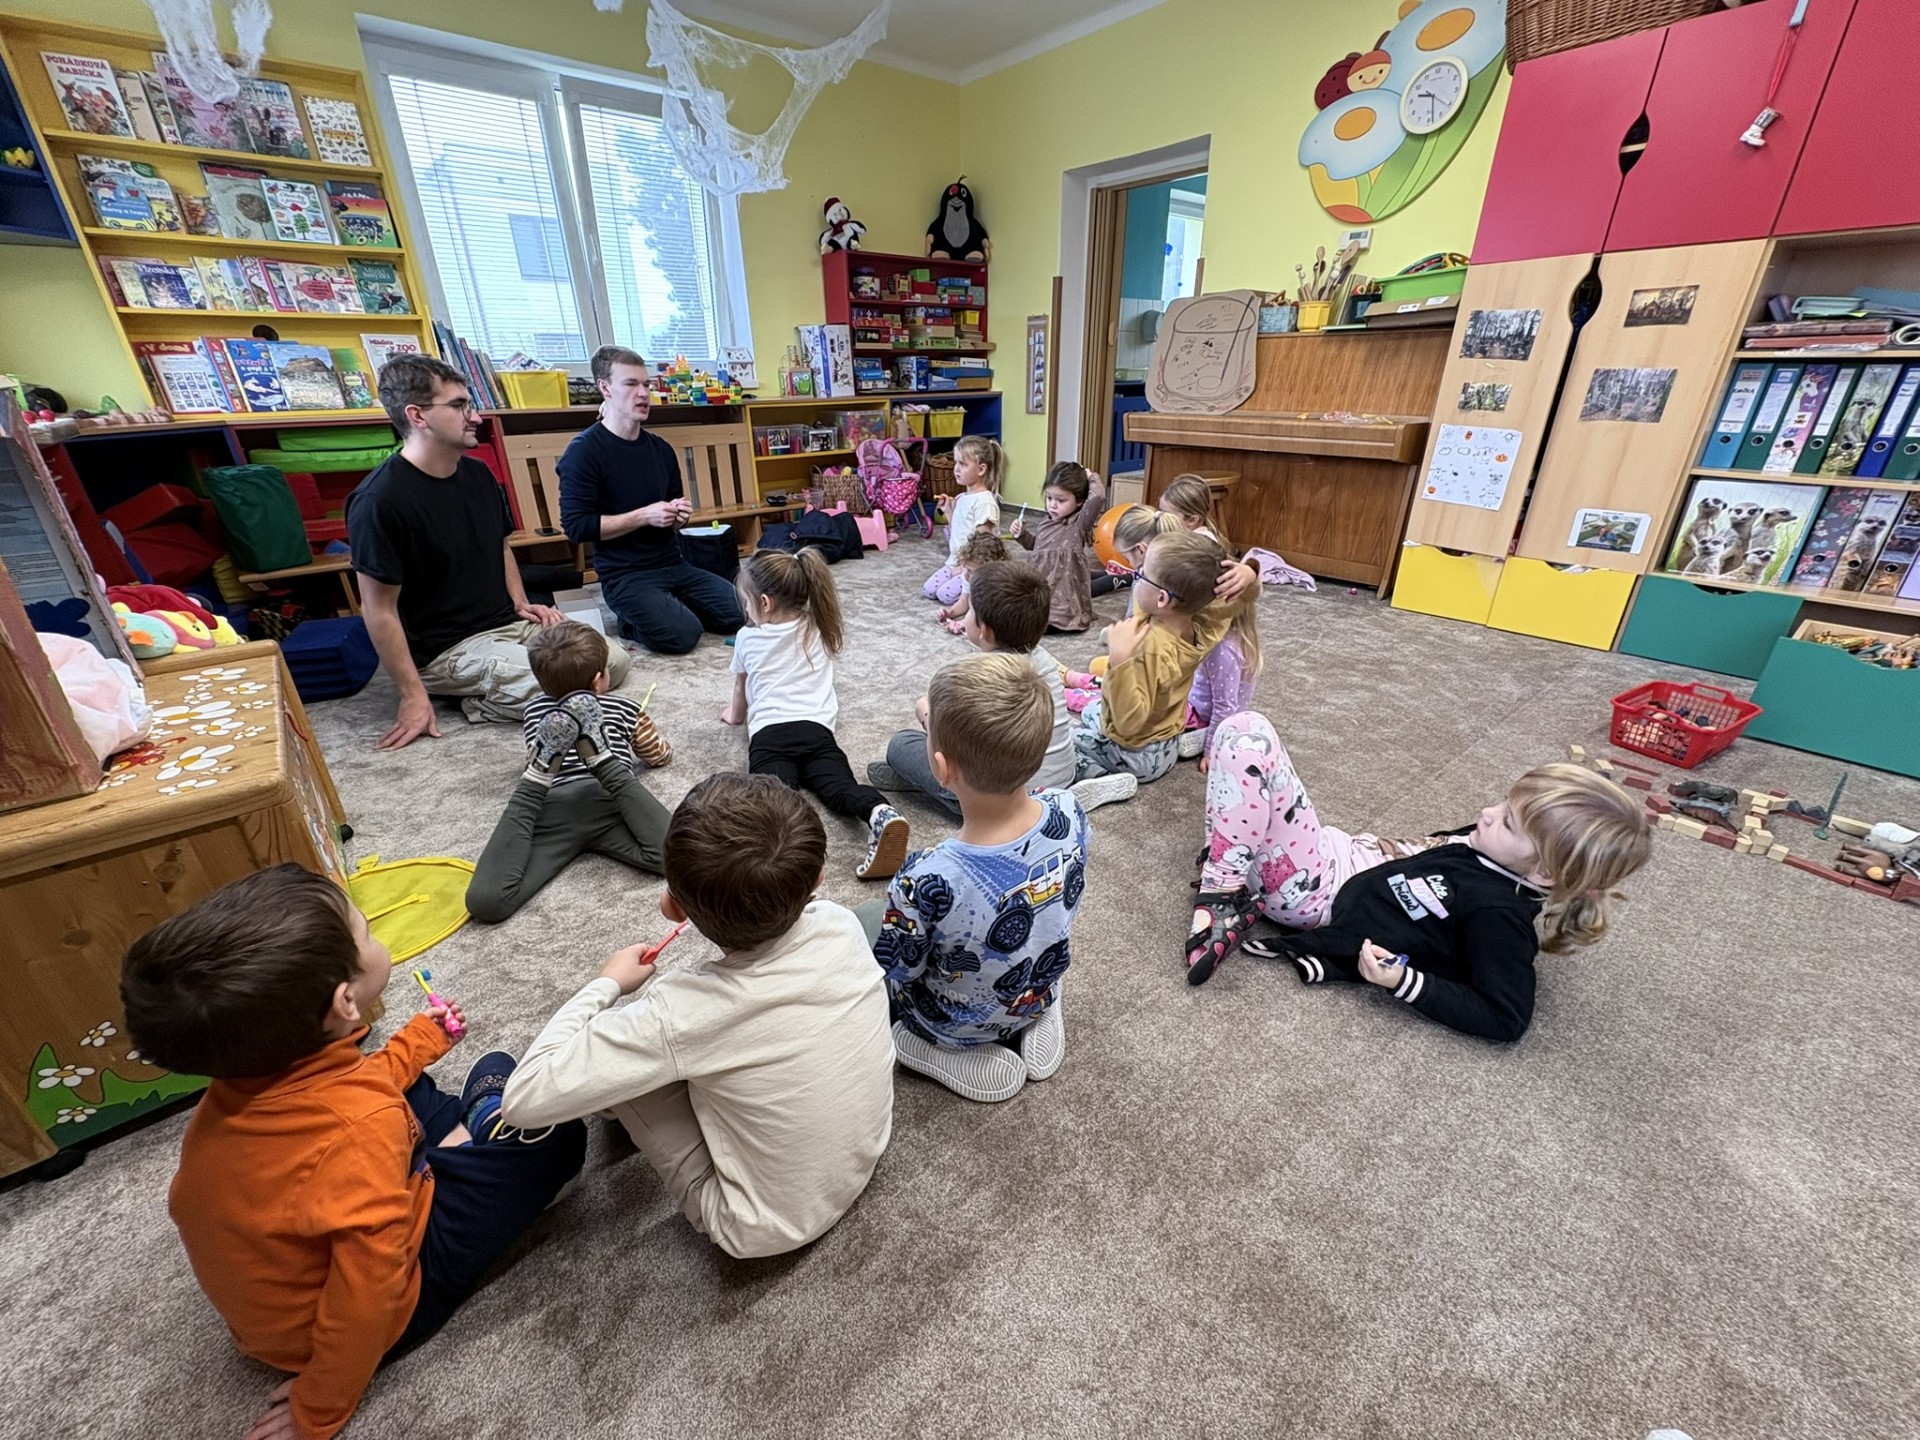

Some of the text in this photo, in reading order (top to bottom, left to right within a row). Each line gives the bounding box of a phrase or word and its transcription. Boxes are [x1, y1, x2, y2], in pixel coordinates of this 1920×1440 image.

[45, 54, 108, 70] POHÁDKOVÁ
[57, 65, 104, 79] BABIČKA
[1426, 874, 1449, 900] Cute
